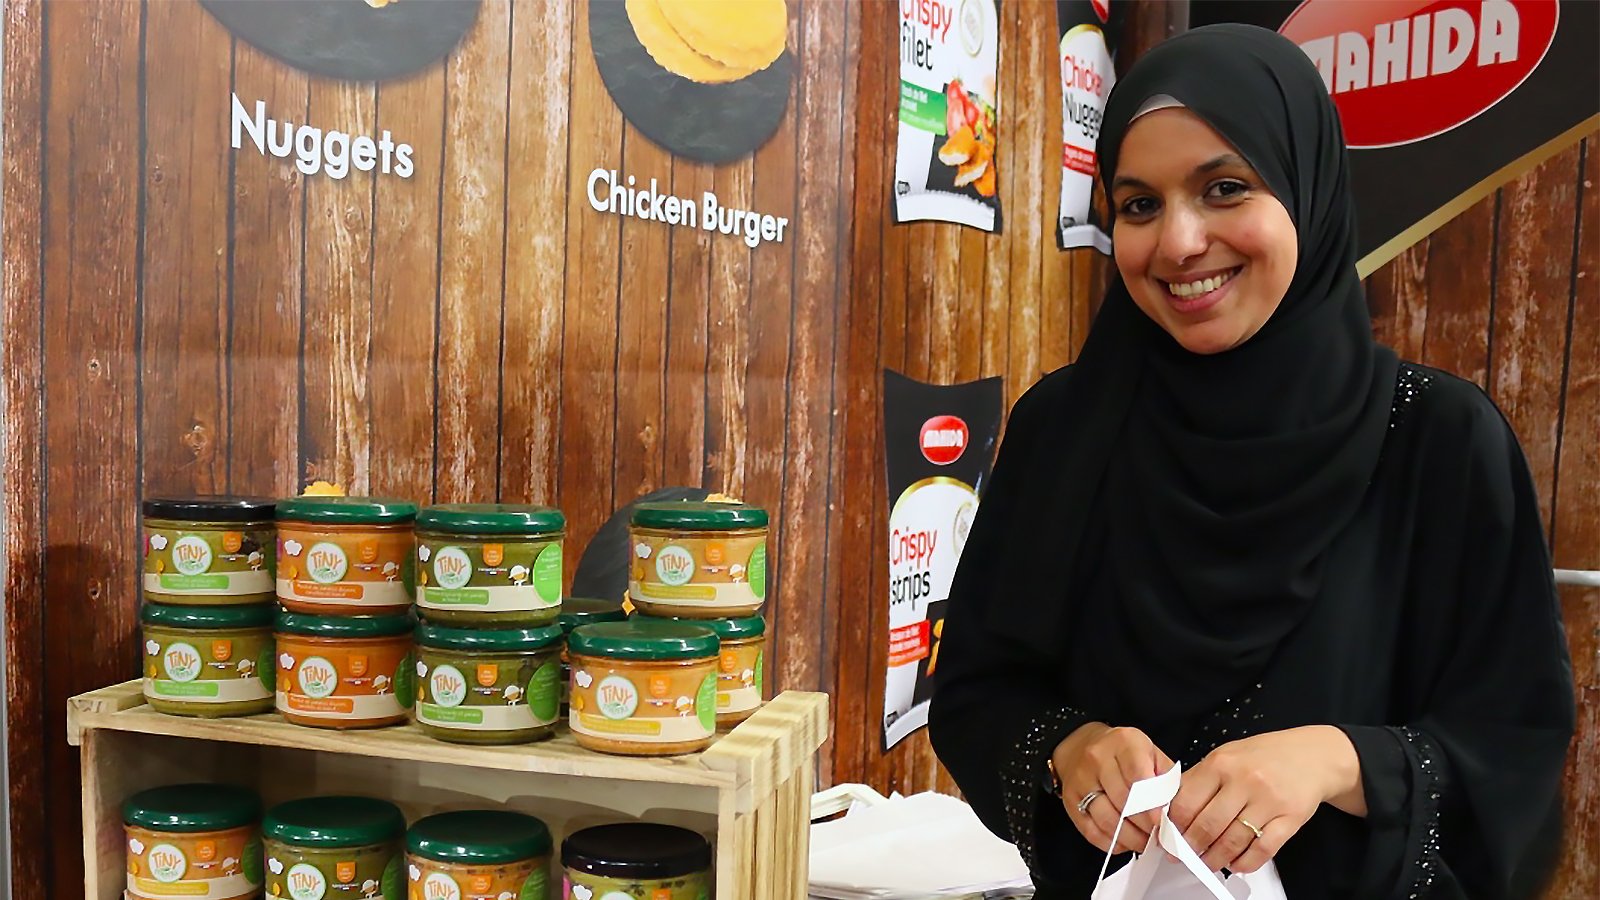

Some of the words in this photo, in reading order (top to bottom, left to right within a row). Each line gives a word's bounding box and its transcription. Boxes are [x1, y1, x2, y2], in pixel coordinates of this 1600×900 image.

[902, 0, 953, 44] Crispy
[902, 20, 934, 71] filet
[1064, 54, 1103, 97] Chicke
[231, 92, 415, 180] Nuggets
[586, 168, 697, 229] Chicken
[702, 192, 789, 248] Burger
[891, 526, 938, 569] Crispy
[891, 566, 931, 611] strips
